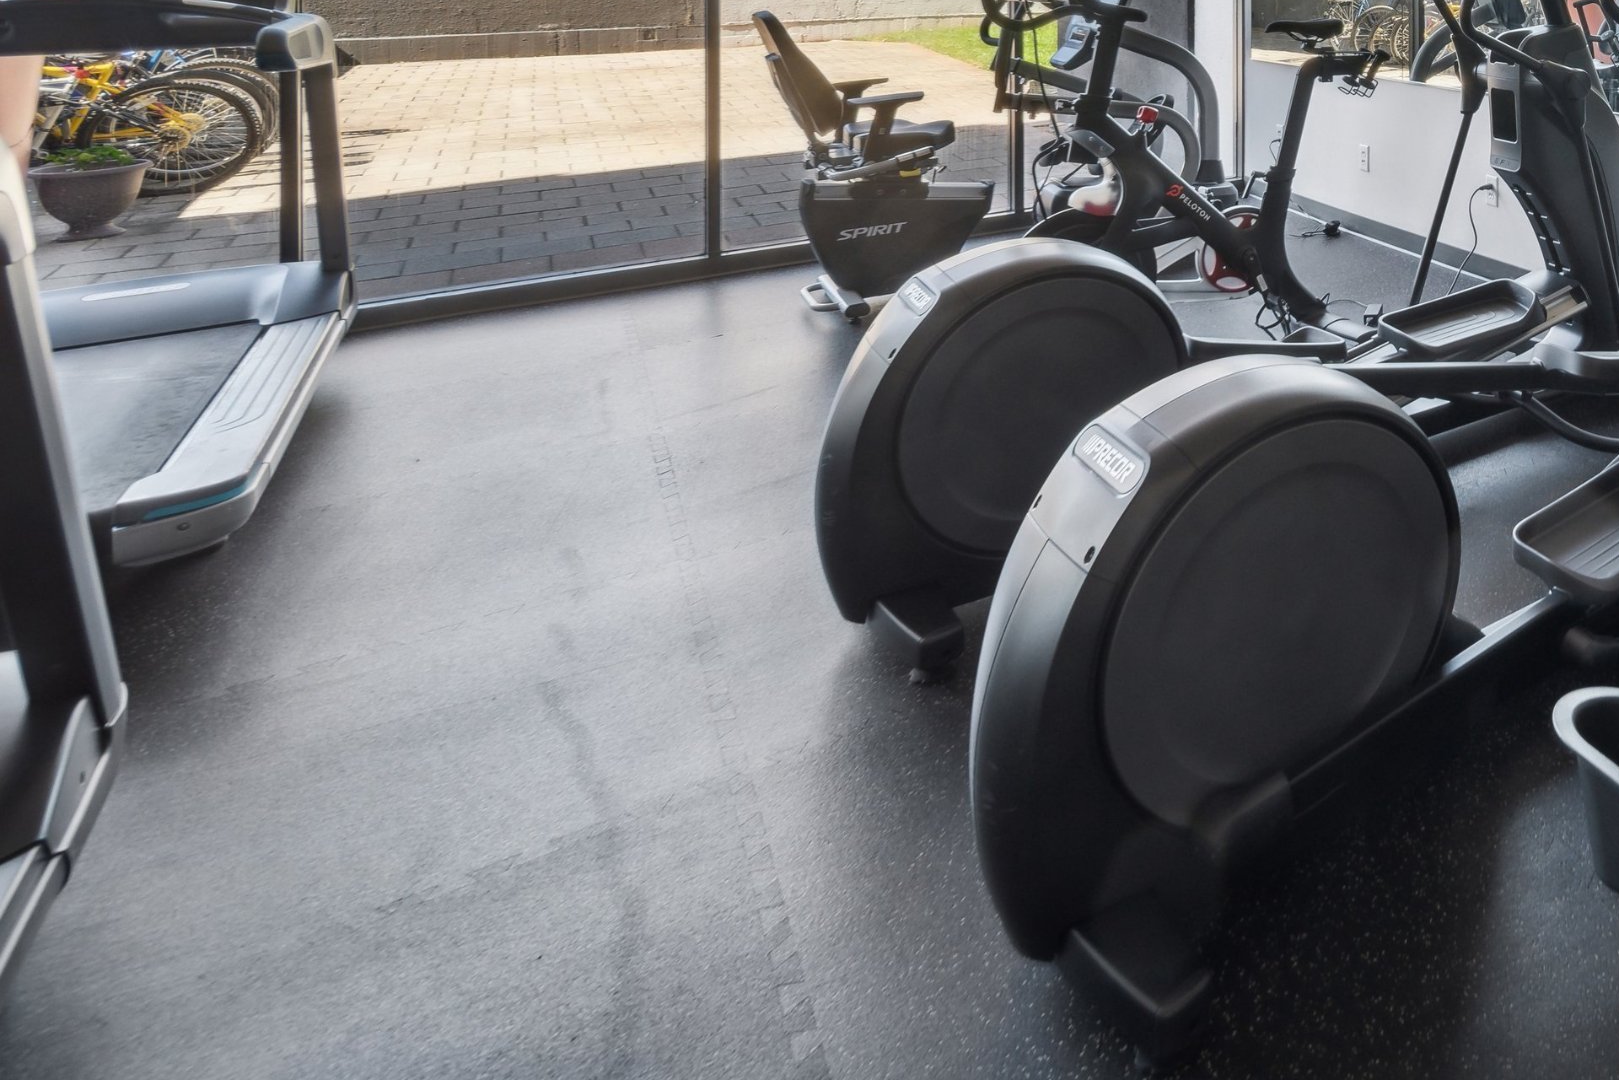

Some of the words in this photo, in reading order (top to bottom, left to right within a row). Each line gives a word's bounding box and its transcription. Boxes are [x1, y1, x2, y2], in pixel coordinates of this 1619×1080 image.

[1179, 193, 1211, 221] PELOTON
[836, 221, 909, 241] SPIRIT
[1085, 436, 1136, 483] PRECOR
